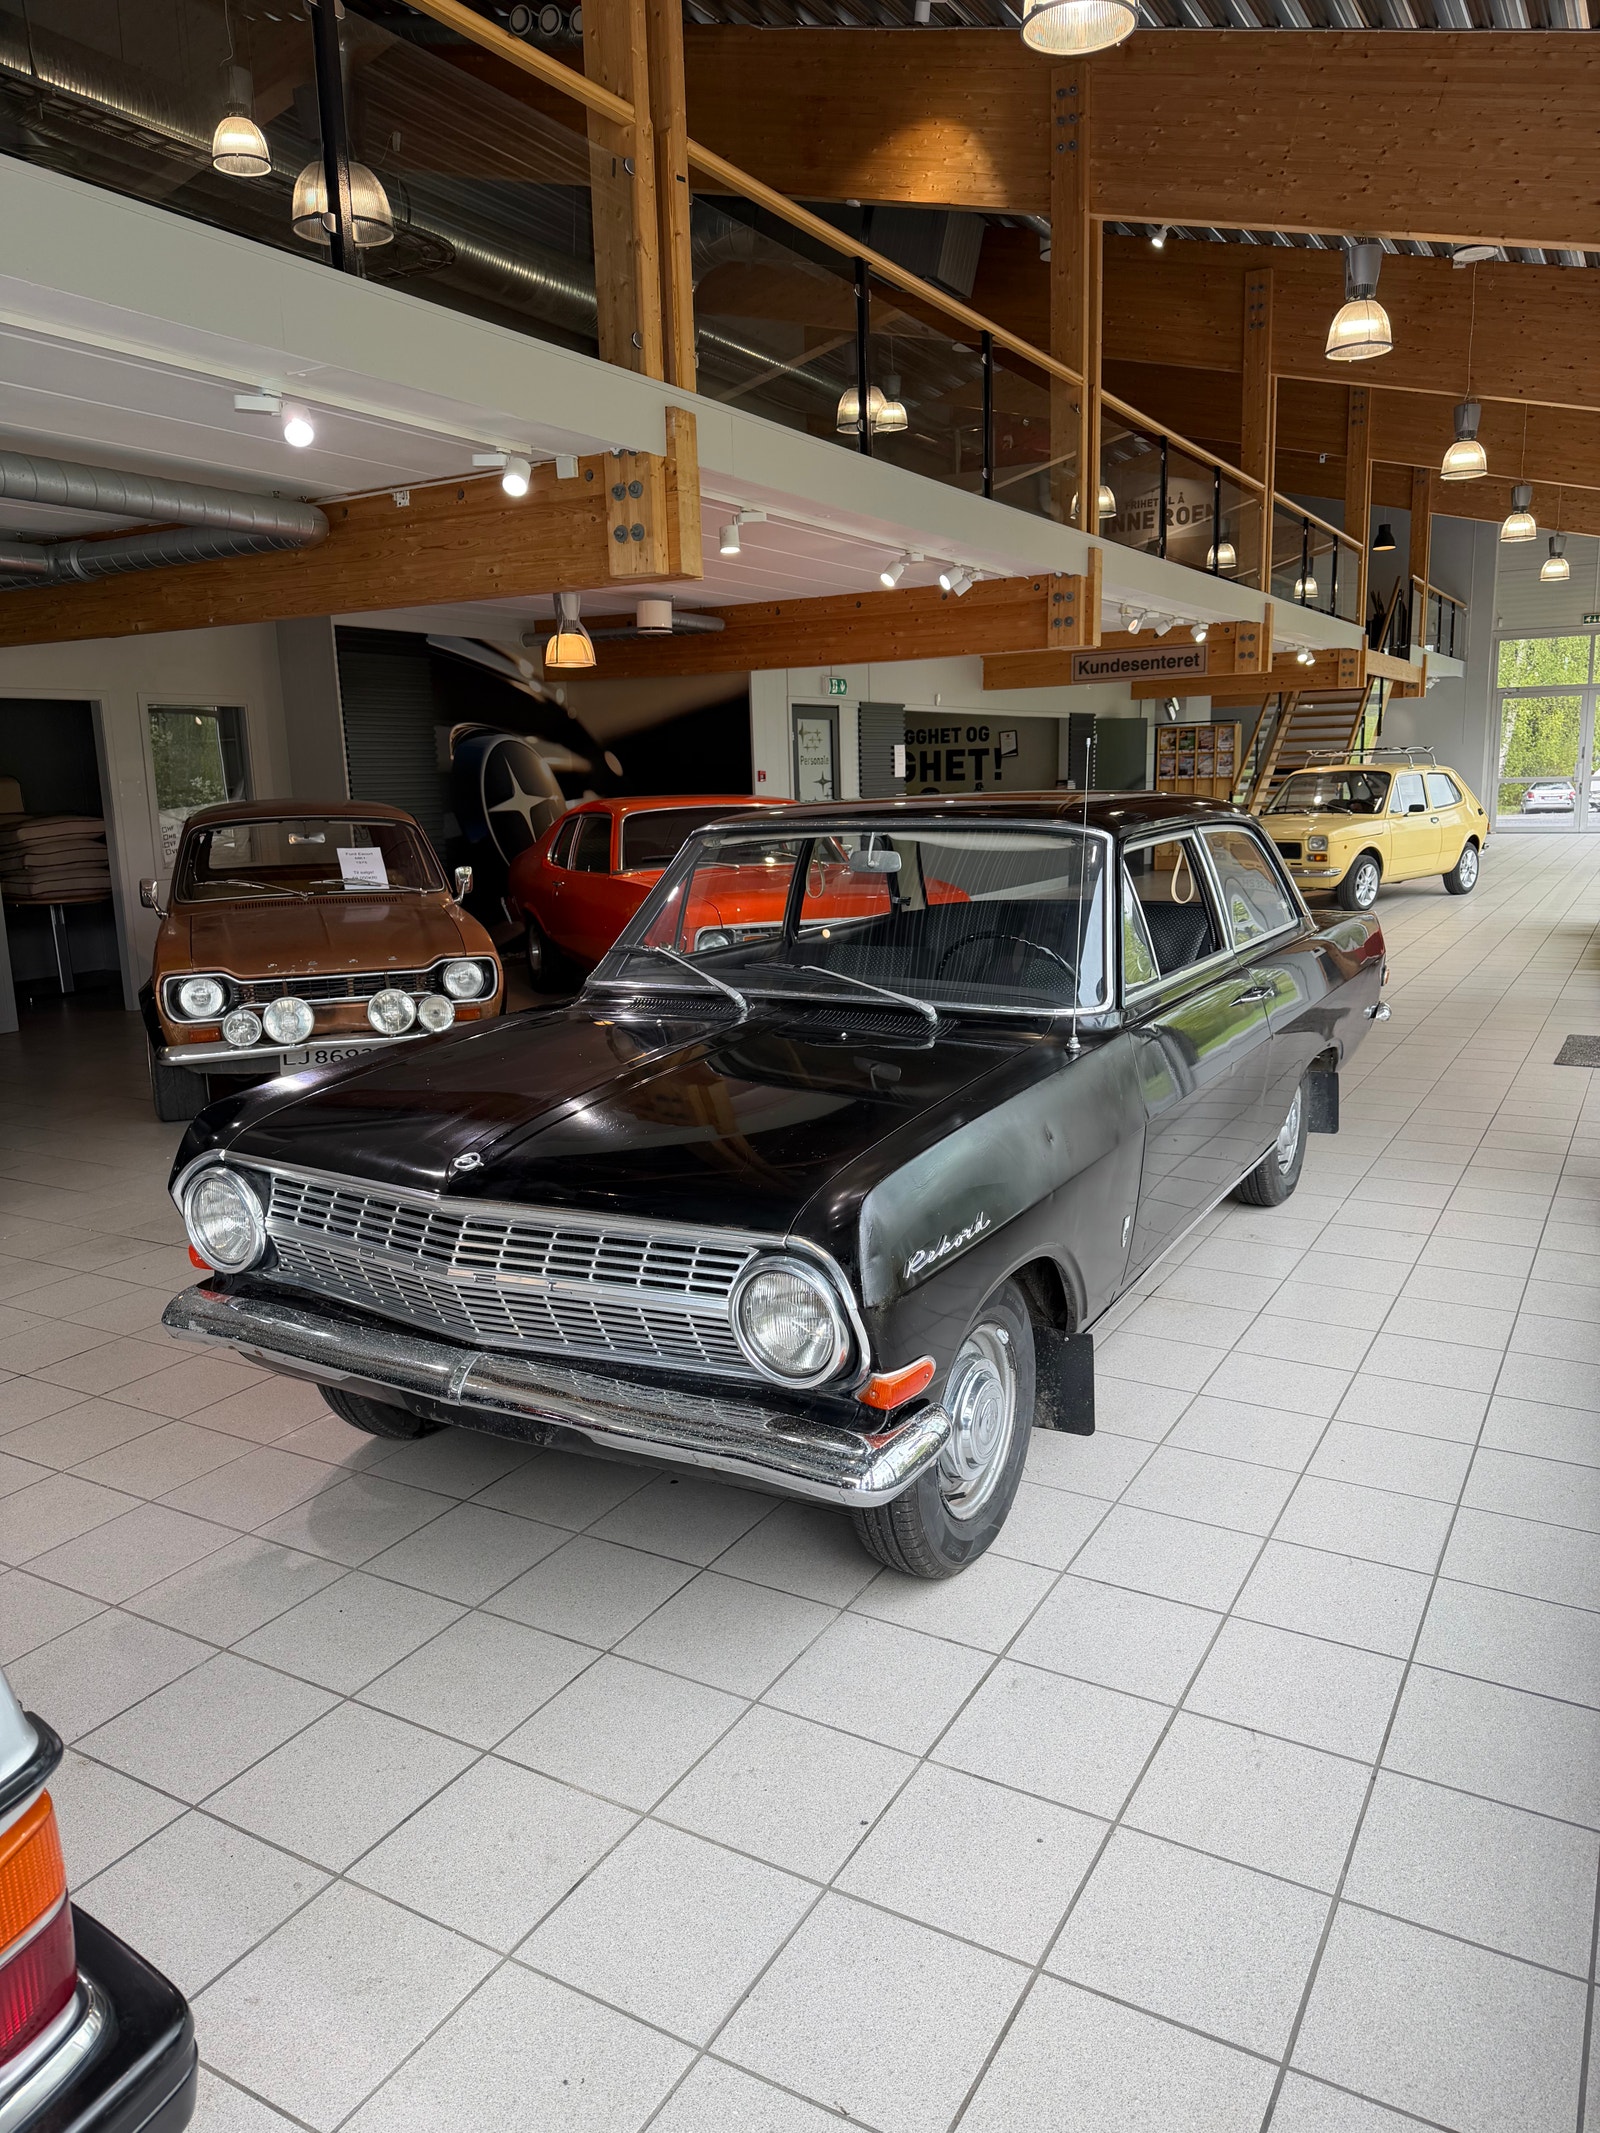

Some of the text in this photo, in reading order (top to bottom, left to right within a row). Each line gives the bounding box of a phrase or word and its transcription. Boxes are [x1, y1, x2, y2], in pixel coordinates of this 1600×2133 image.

[1125, 498, 1159, 511] FRIHET
[1177, 492, 1185, 504] Å
[1103, 510, 1155, 534] INNE
[1078, 652, 1200, 675] Kundesenteret
[966, 725, 989, 742] OG
[800, 755, 830, 766] Personale
[903, 1211, 991, 1279] Rekord
